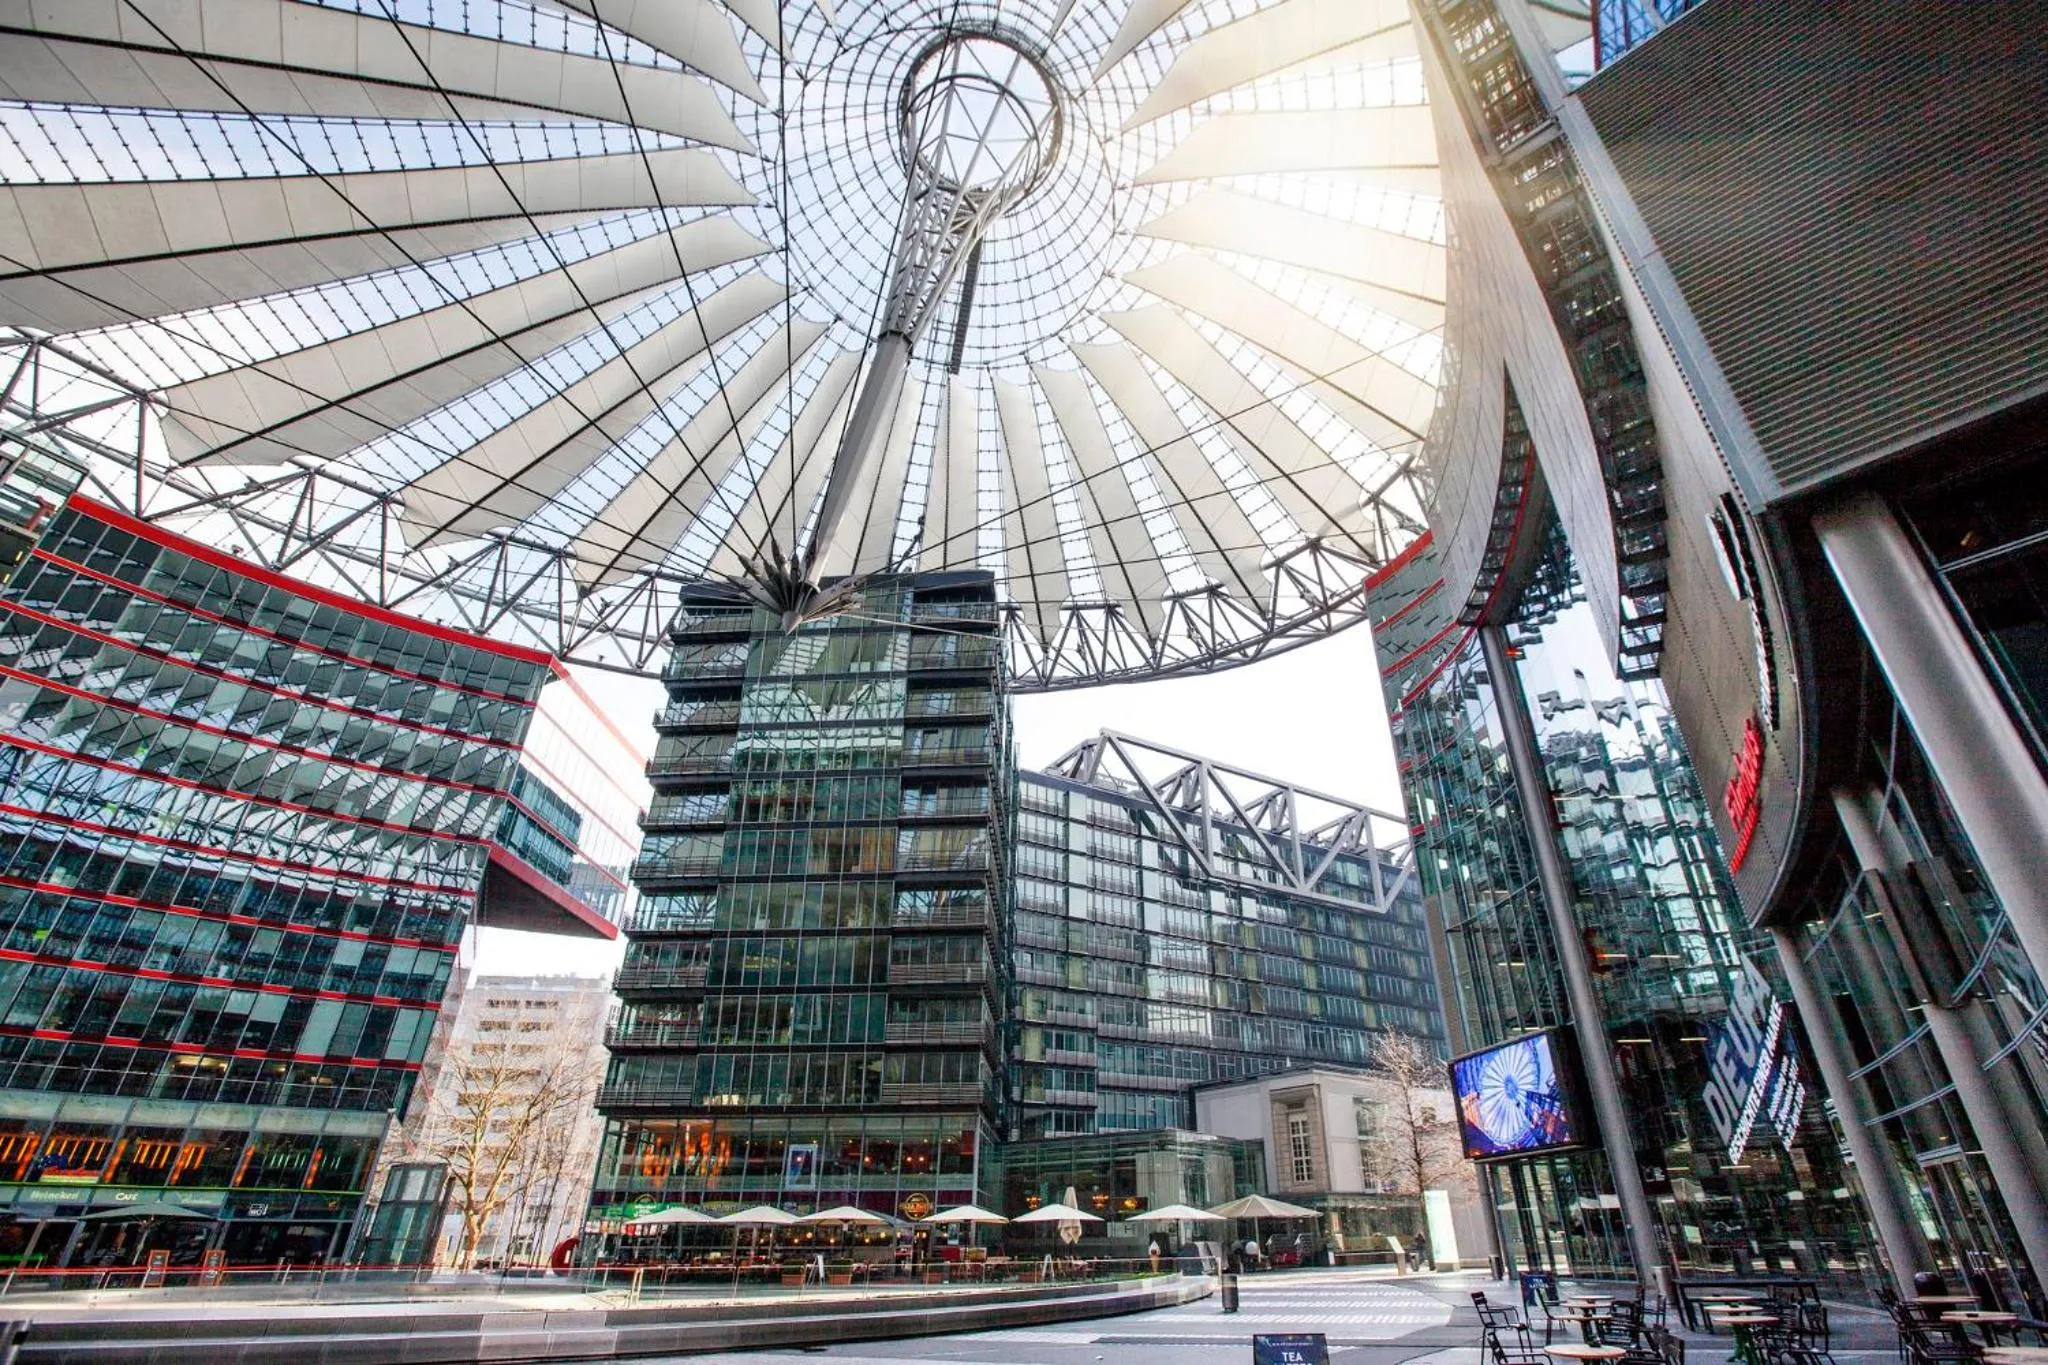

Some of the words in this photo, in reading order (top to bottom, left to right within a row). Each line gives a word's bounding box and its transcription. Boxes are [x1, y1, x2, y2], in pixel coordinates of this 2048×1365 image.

[1702, 1035, 1748, 1147] DIE
[1725, 951, 1772, 1069] UFA
[1281, 1351, 1304, 1362] TEA
